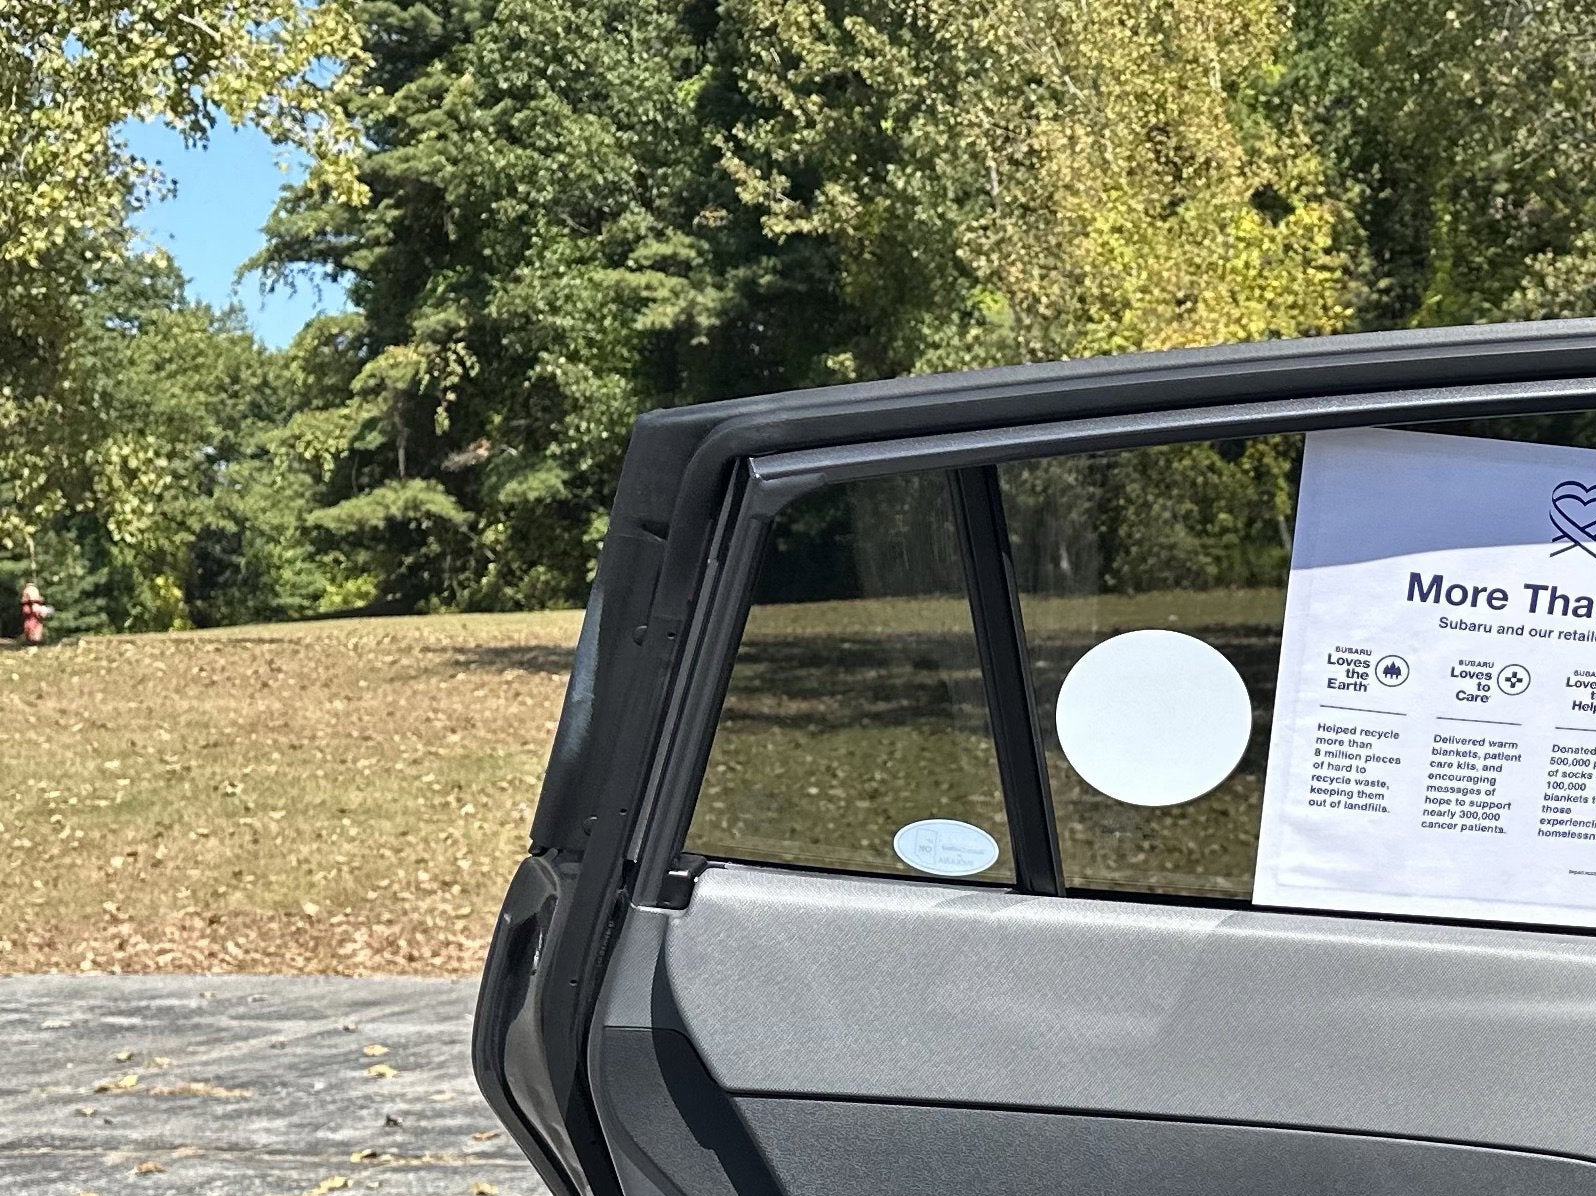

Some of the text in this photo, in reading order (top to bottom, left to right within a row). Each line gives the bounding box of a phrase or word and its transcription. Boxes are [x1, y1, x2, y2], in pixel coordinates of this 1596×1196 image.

[1406, 571, 1509, 611] More
[1437, 615, 1493, 634] Subaru
[1495, 624, 1525, 637] and
[1527, 627, 1555, 639] our
[1327, 653, 1371, 669] Loves
[1345, 668, 1370, 681] the
[1450, 666, 1493, 681] Loves
[1476, 681, 1491, 693] to
[1317, 722, 1400, 740] Helped recycle
[1316, 737, 1373, 750] more than
[1434, 734, 1519, 750] Delivered warm
[1314, 748, 1401, 765] 8 million pieces
[1431, 746, 1522, 763] blankets, patient
[1313, 761, 1367, 774] of hard to
[1429, 761, 1503, 773] care kits, and
[1549, 756, 1591, 768] 500,000
[1427, 773, 1497, 787] encouraging
[1547, 769, 1559, 778] of
[1561, 771, 1594, 780] socks
[1311, 775, 1390, 790] recycle waste,
[1546, 781, 1587, 792] 100,000
[1310, 785, 1385, 801] keeping them
[1426, 785, 1497, 797] messages of
[1424, 795, 1512, 811] hope to support
[1544, 792, 1590, 804] blankets
[1308, 799, 1390, 814] out of landfills.
[1542, 805, 1572, 815] those
[1423, 809, 1501, 822] nearly 300,000
[1421, 821, 1507, 834] cancer patients.
